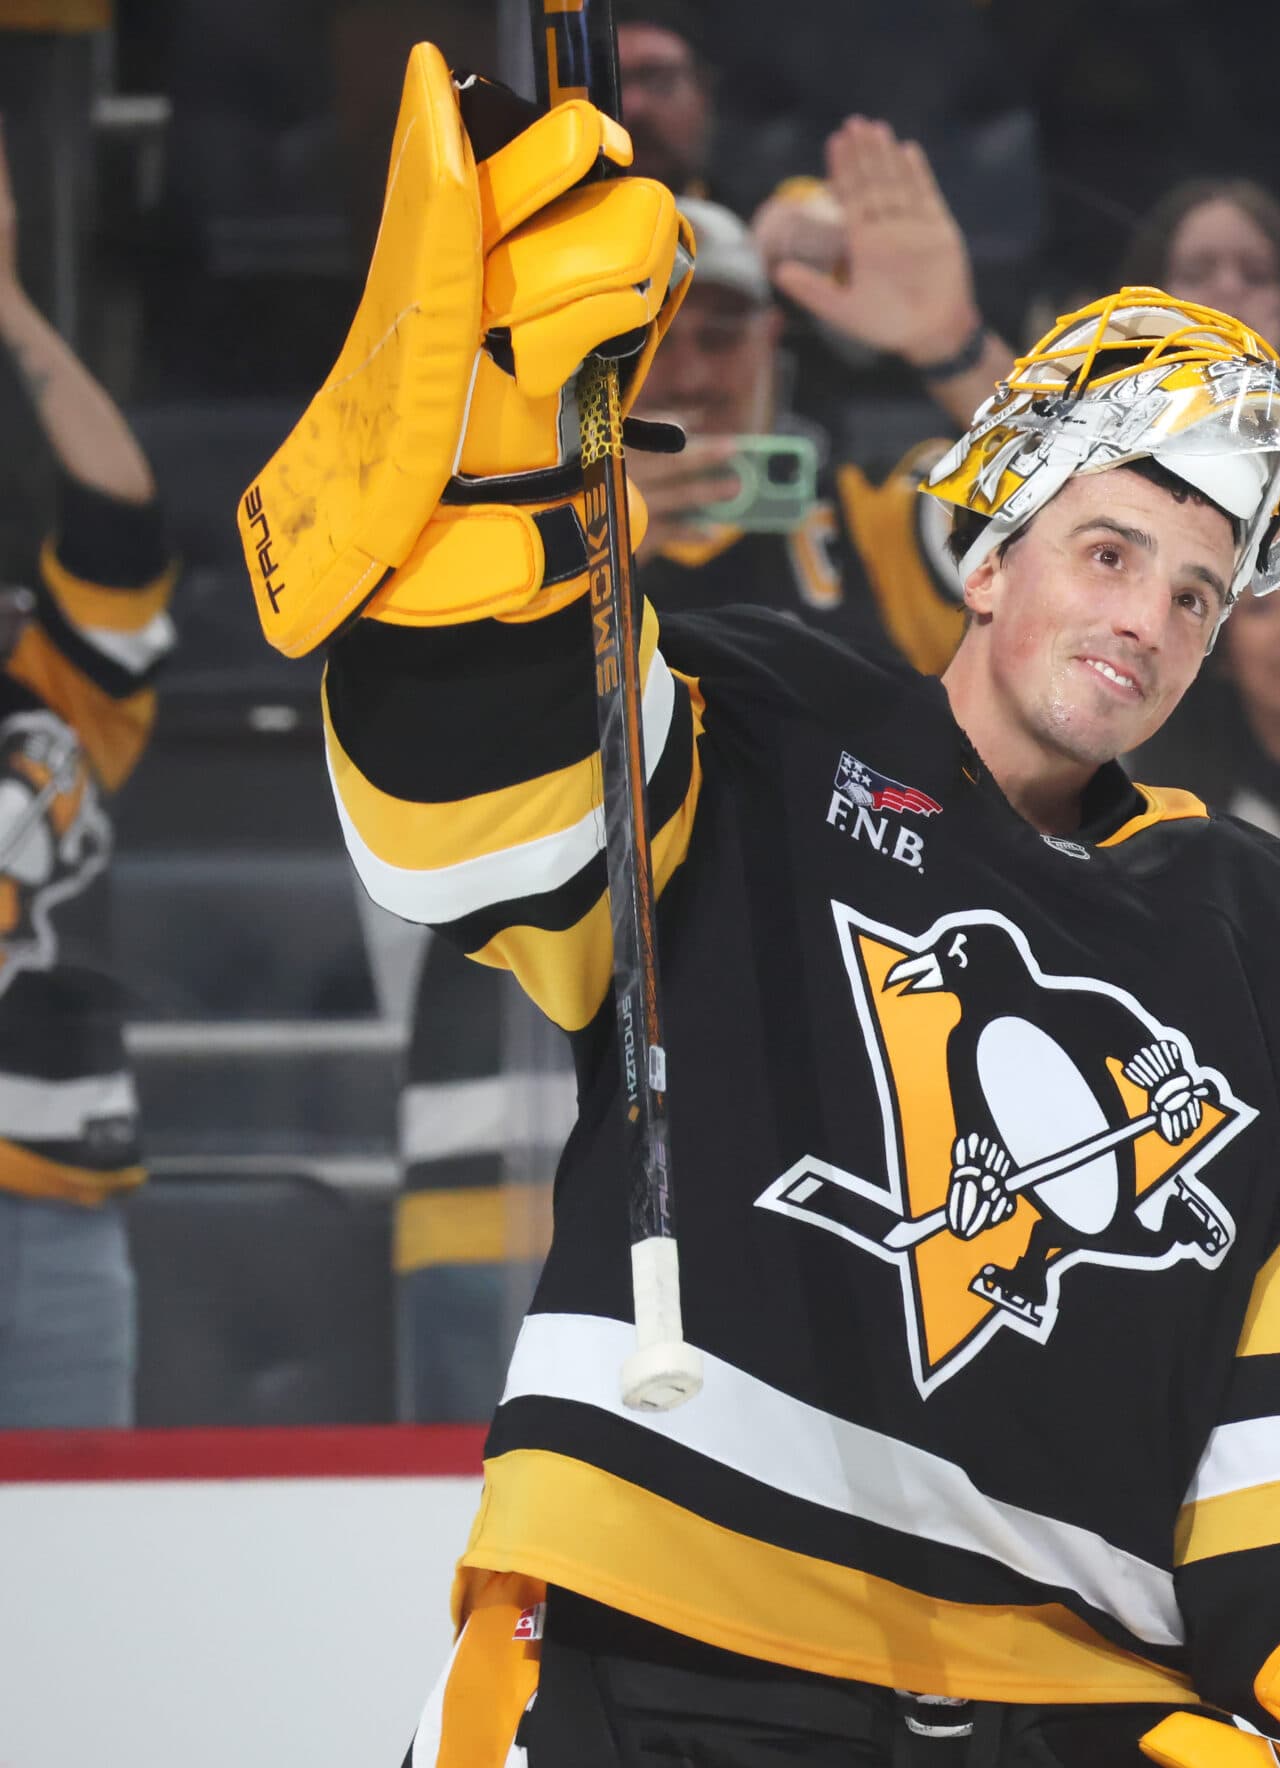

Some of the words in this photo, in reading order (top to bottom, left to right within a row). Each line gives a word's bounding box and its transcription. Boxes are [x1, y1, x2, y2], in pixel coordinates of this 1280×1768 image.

[244, 485, 285, 614] TRUE
[585, 482, 618, 697] SMOKE
[826, 790, 925, 874] F.N.B.
[622, 994, 638, 1102] HZRDUS
